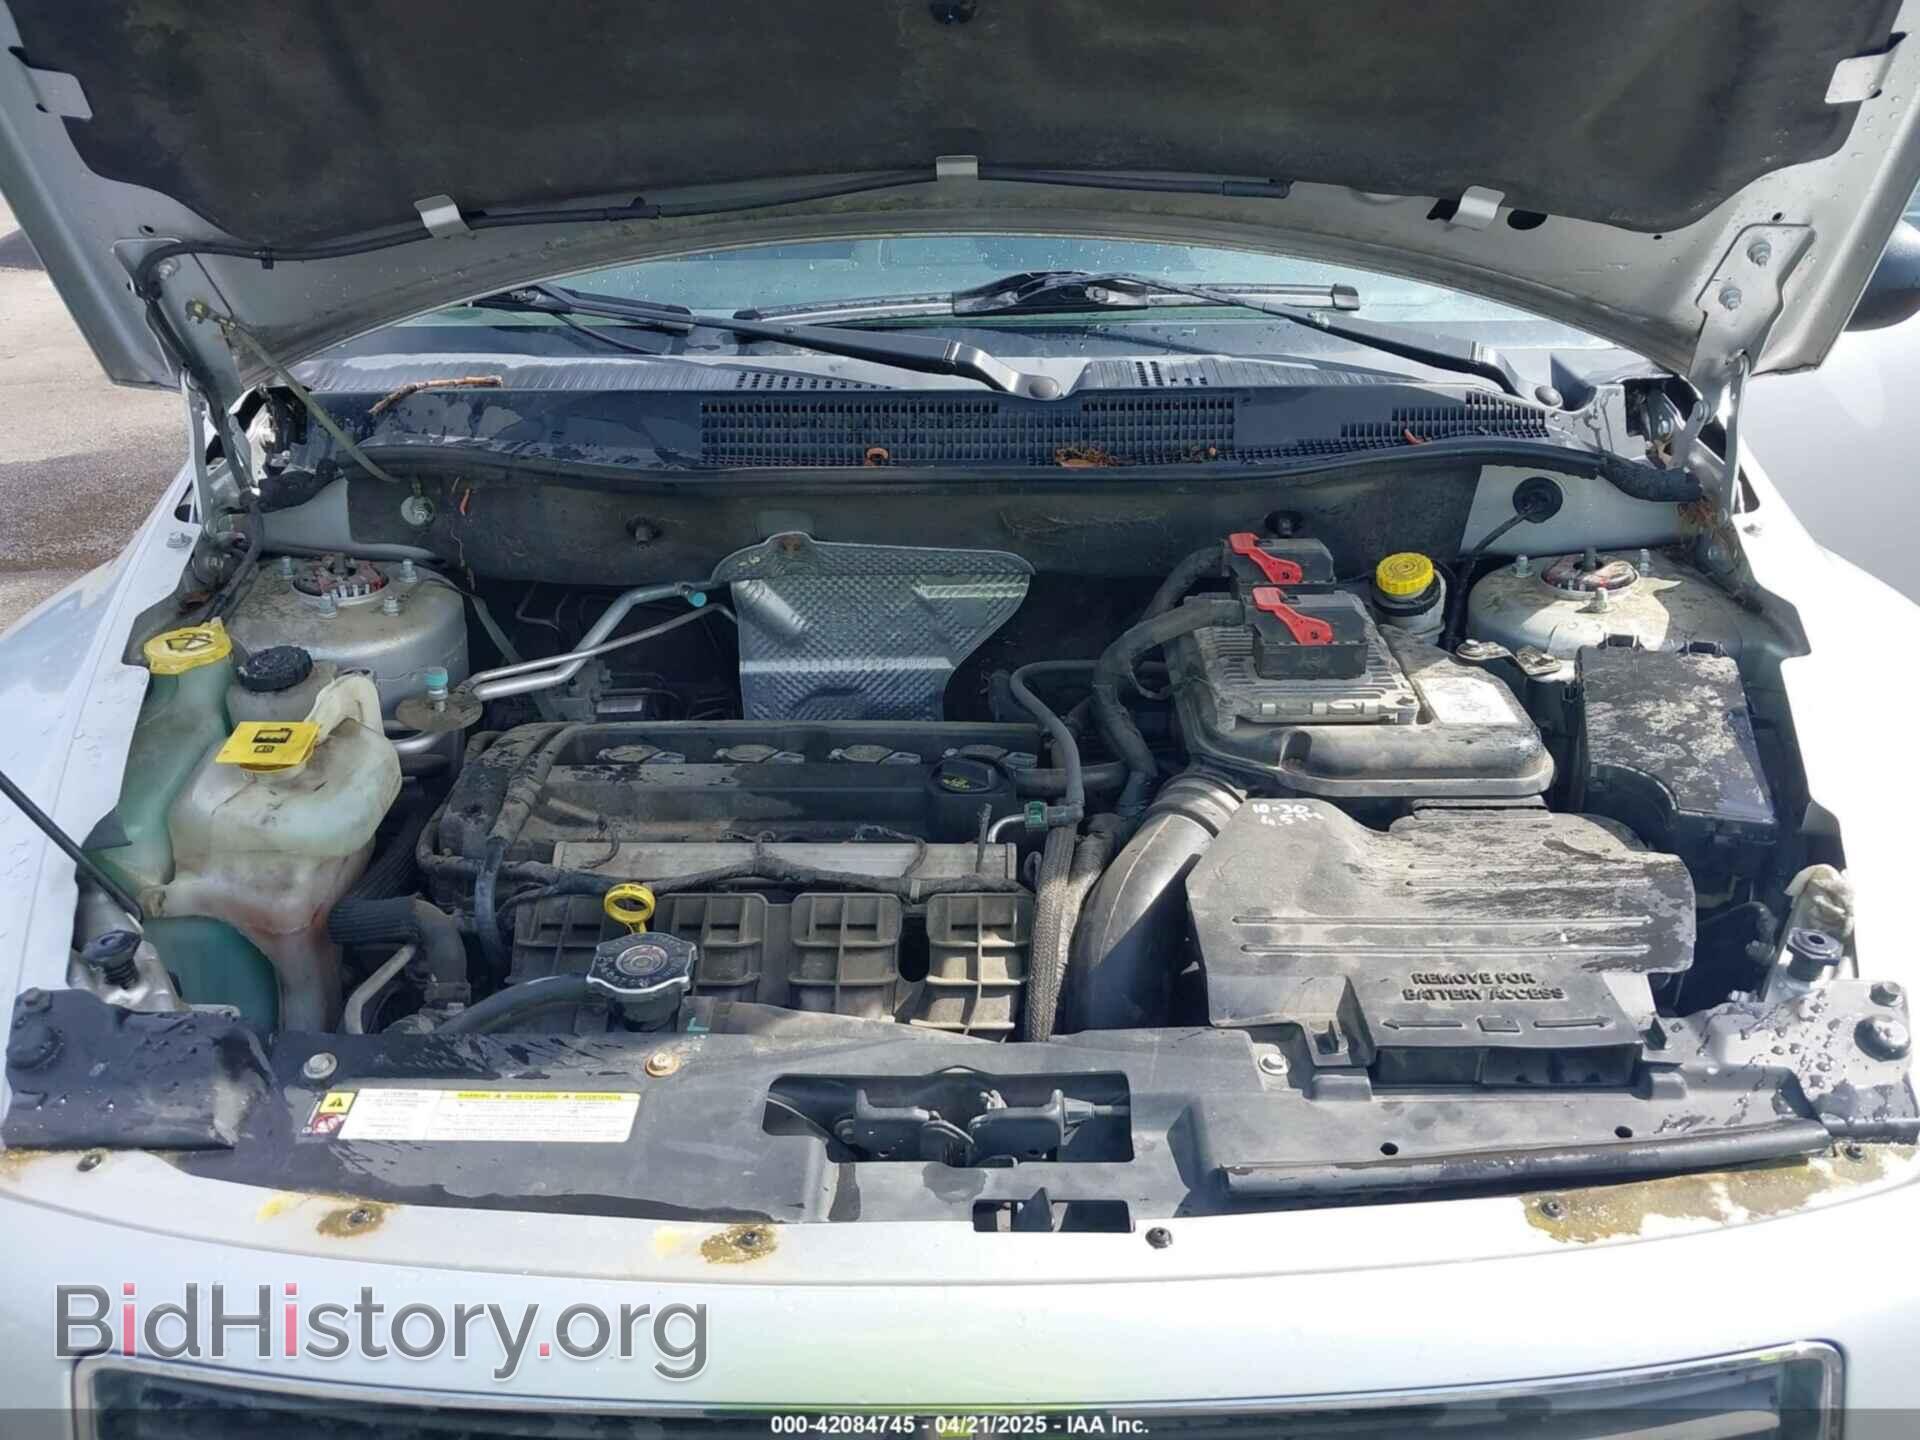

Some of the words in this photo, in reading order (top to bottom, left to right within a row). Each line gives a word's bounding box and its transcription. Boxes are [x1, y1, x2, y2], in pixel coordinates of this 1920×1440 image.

[1410, 972, 1493, 985] REMOVE
[1495, 972, 1537, 985] FOR
[1402, 987, 1483, 1001] BATTERY
[1489, 987, 1566, 1001] ACCESS
